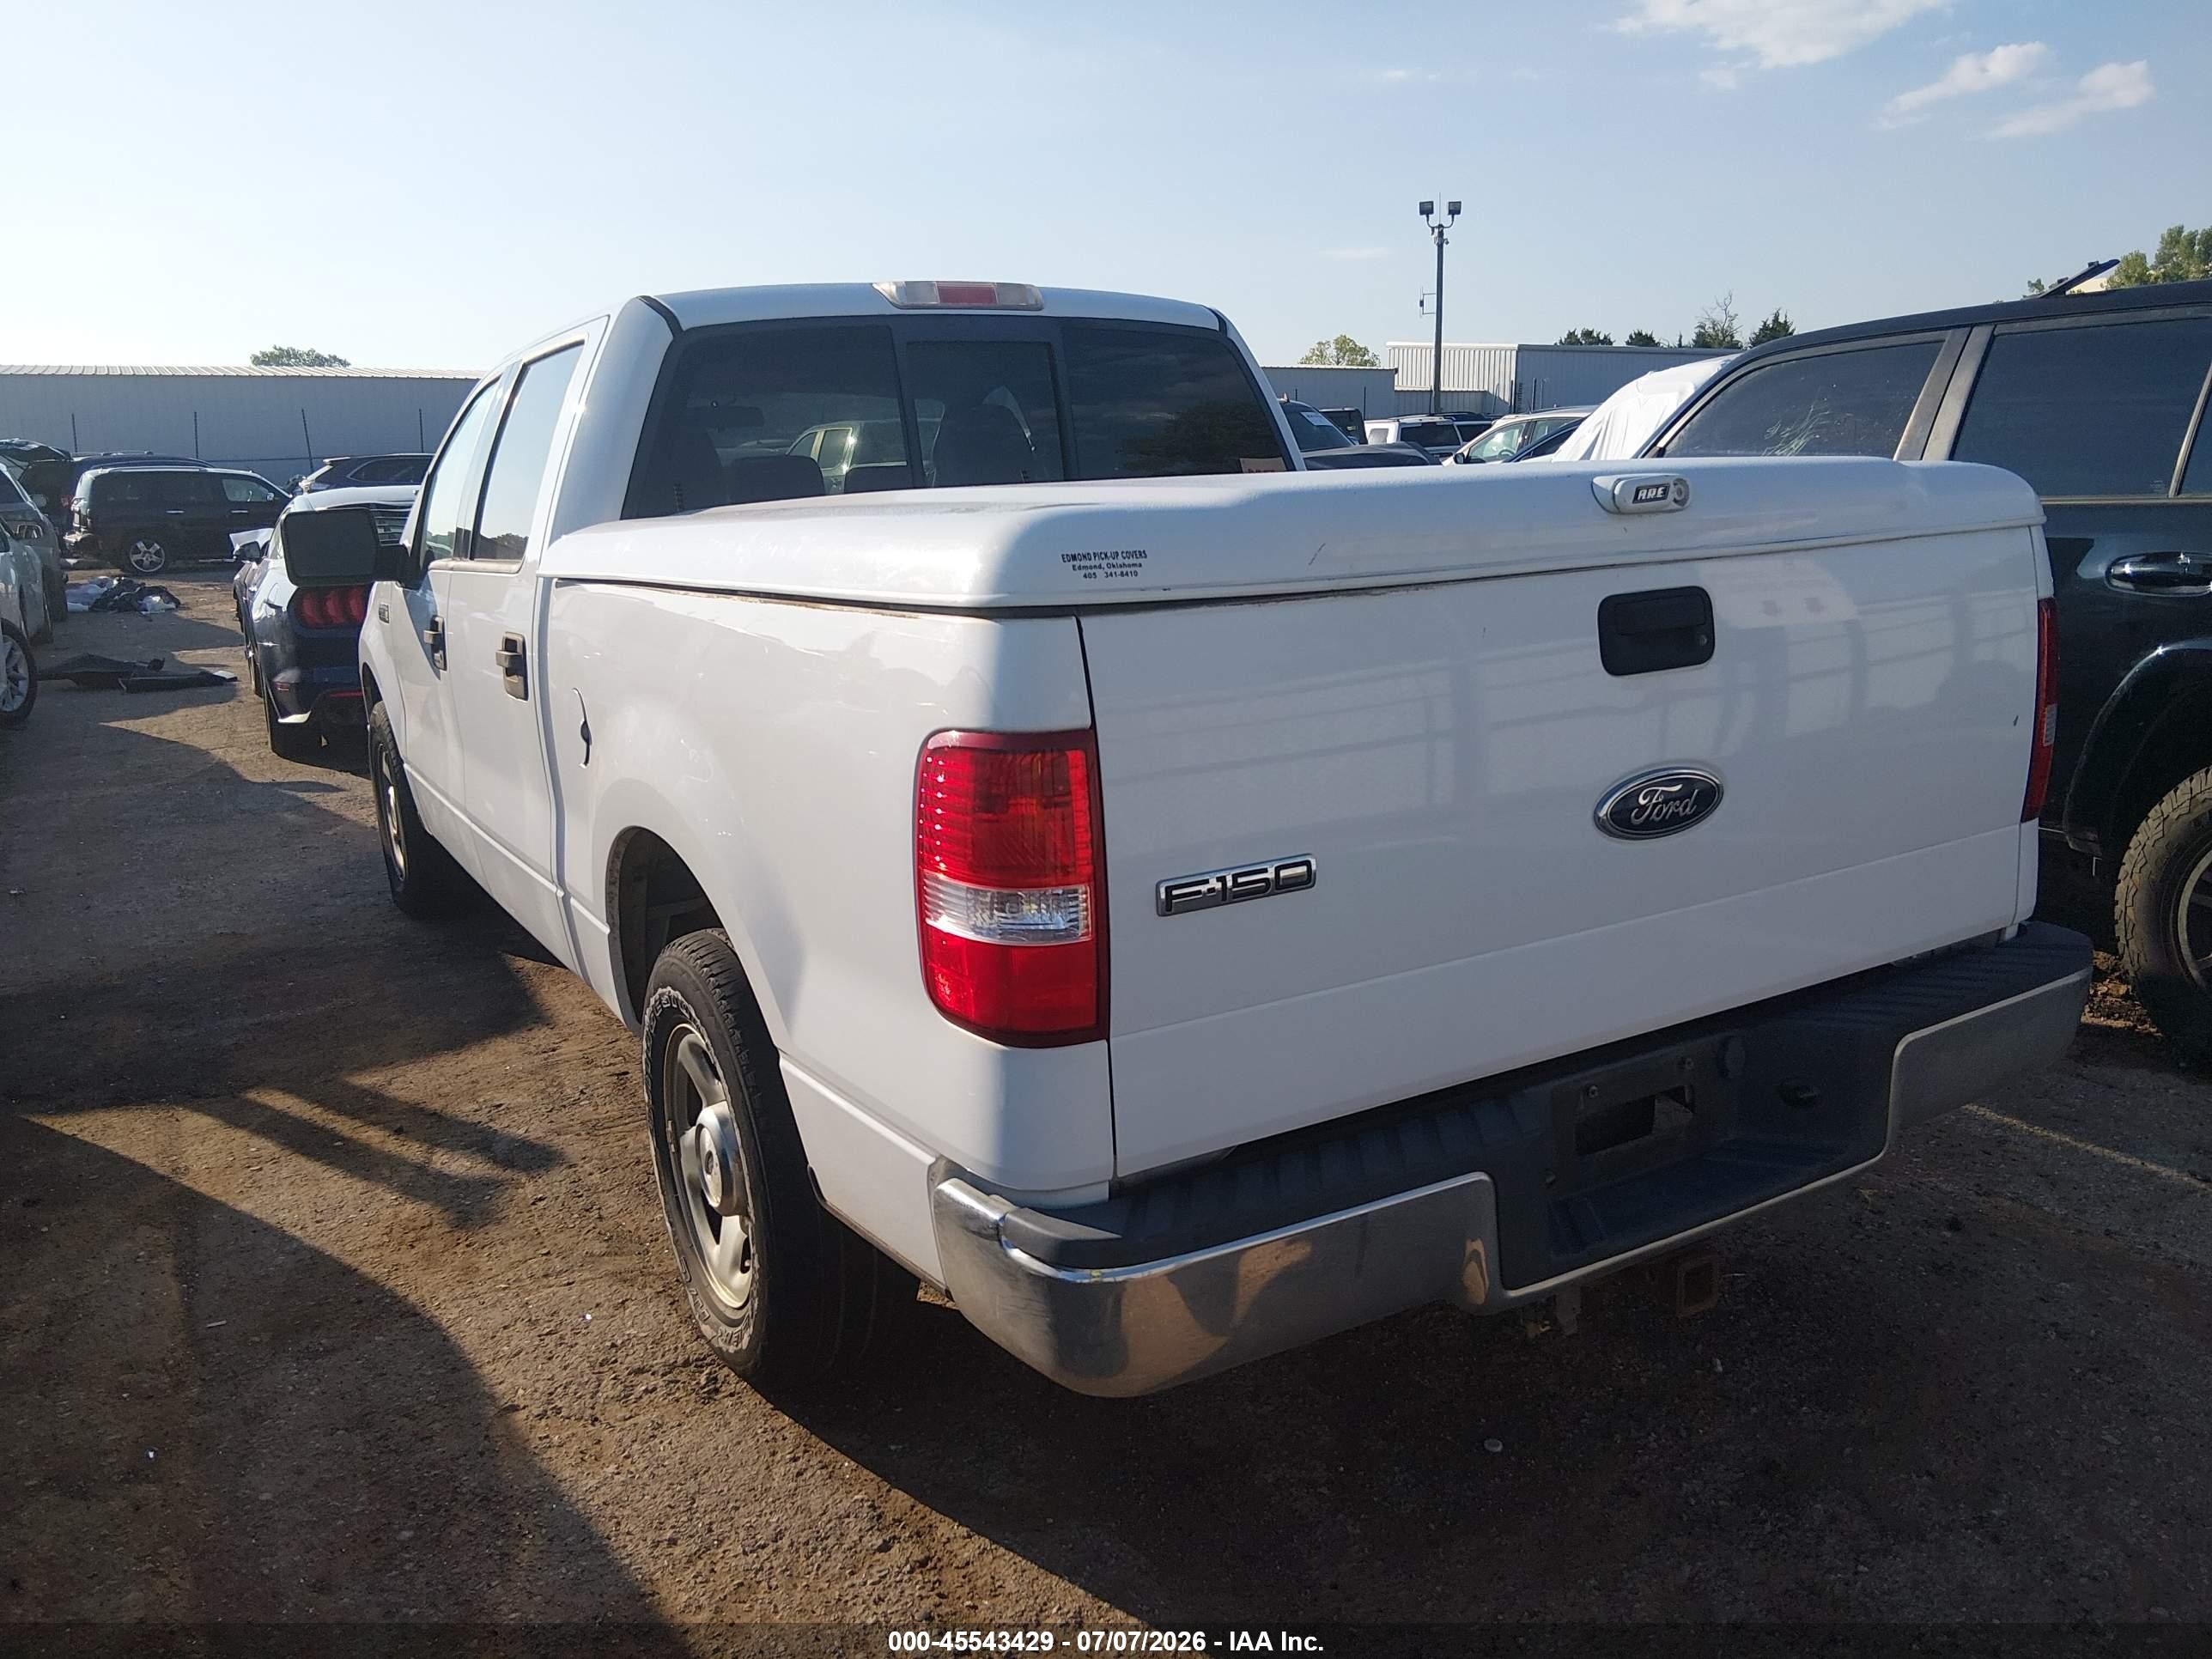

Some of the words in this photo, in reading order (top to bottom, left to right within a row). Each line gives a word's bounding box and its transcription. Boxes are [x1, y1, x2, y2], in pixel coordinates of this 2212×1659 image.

[1061, 553, 1092, 562] EDMOND
[1093, 551, 1119, 561] PICK-UP
[1121, 550, 1147, 560] COVERS
[1631, 783, 1699, 825] Ford
